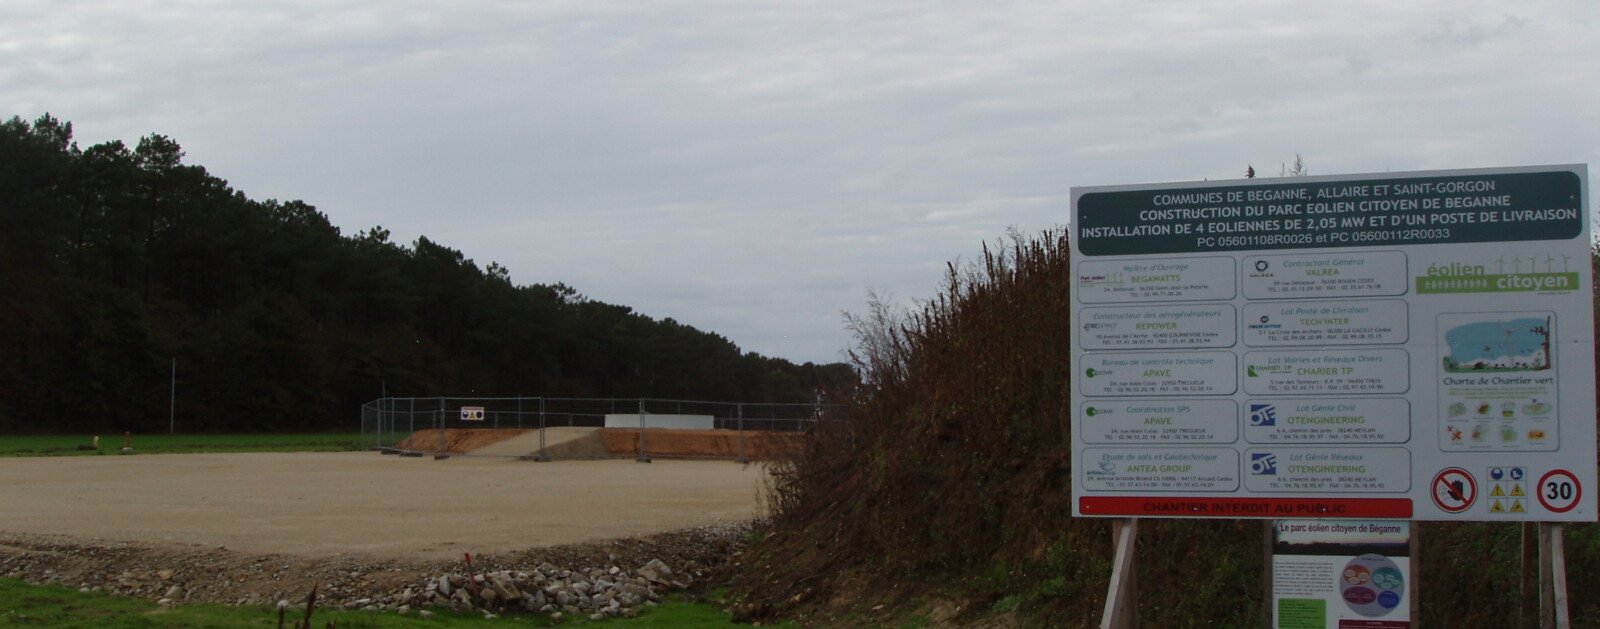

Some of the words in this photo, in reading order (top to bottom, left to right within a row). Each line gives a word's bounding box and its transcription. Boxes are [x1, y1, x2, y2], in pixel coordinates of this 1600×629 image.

[1153, 192, 1223, 206] COMMUNES
[1227, 191, 1242, 203] DE
[1248, 188, 1312, 202] BEGANNE,
[1317, 185, 1370, 199] ALLAIRE
[1373, 184, 1391, 196] ET
[1393, 180, 1495, 196] SAINT-GORGON
[1139, 206, 1241, 222] CONSTRUCTION
[1245, 205, 1264, 217] DU
[1268, 203, 1302, 216] PARC
[1306, 201, 1355, 214] EOLIEN
[1359, 199, 1419, 212] CITOYEN
[1422, 197, 1441, 210] DE
[1445, 195, 1511, 209] BEGANNE
[1081, 223, 1171, 239] INSTALLATION
[1174, 223, 1192, 235] DE
[1195, 222, 1205, 234] 4
[1208, 220, 1281, 233] EOLIENNES
[1284, 219, 1302, 230] DE
[1306, 217, 1337, 231] 2,05
[1341, 216, 1366, 228] MW
[1369, 215, 1387, 227] ET
[1391, 213, 1426, 226] D'UN
[1430, 211, 1476, 225] POSTE
[1479, 211, 1498, 223] DE
[1502, 208, 1577, 222] LIVRAISON
[1197, 237, 1215, 248] PC
[1218, 234, 1313, 247] 05601108R0026
[1316, 234, 1328, 244] et
[1330, 230, 1349, 243] PC
[1352, 228, 1450, 242] 05600112R0033
[1305, 268, 1340, 277] VALREA
[1427, 262, 1485, 277] éolien
[1131, 274, 1181, 284] BEGAWATTS
[1496, 274, 1569, 292] citoyen
[1135, 322, 1178, 330] REPOWER
[1300, 317, 1349, 326] TECH'INTER
[1143, 369, 1172, 377] APAVE
[1297, 367, 1338, 376] CHARIER
[1341, 367, 1354, 375] TP
[1443, 376, 1476, 386] Charte
[1477, 376, 1489, 386] de
[1491, 376, 1532, 386] Chantier
[1535, 376, 1554, 385] vert
[1144, 417, 1172, 425] APAVE
[1287, 416, 1365, 425] OTENGINEERING
[1126, 465, 1158, 473] ANTEA
[1159, 464, 1192, 473] GROUP
[1288, 465, 1366, 474] OTENGINEERING
[1546, 481, 1572, 500] 30
[1143, 502, 1209, 513] CHANTIER
[1211, 503, 1272, 513] INTERDIT
[1274, 503, 1293, 513] AU
[1297, 503, 1346, 514] PUBLIC
[1280, 523, 1289, 532] Le
[1290, 524, 1306, 533] parc
[1308, 523, 1330, 532] éolien
[1331, 524, 1357, 535] citoyen
[1359, 523, 1368, 533] de
[1369, 524, 1401, 535] Béganne
